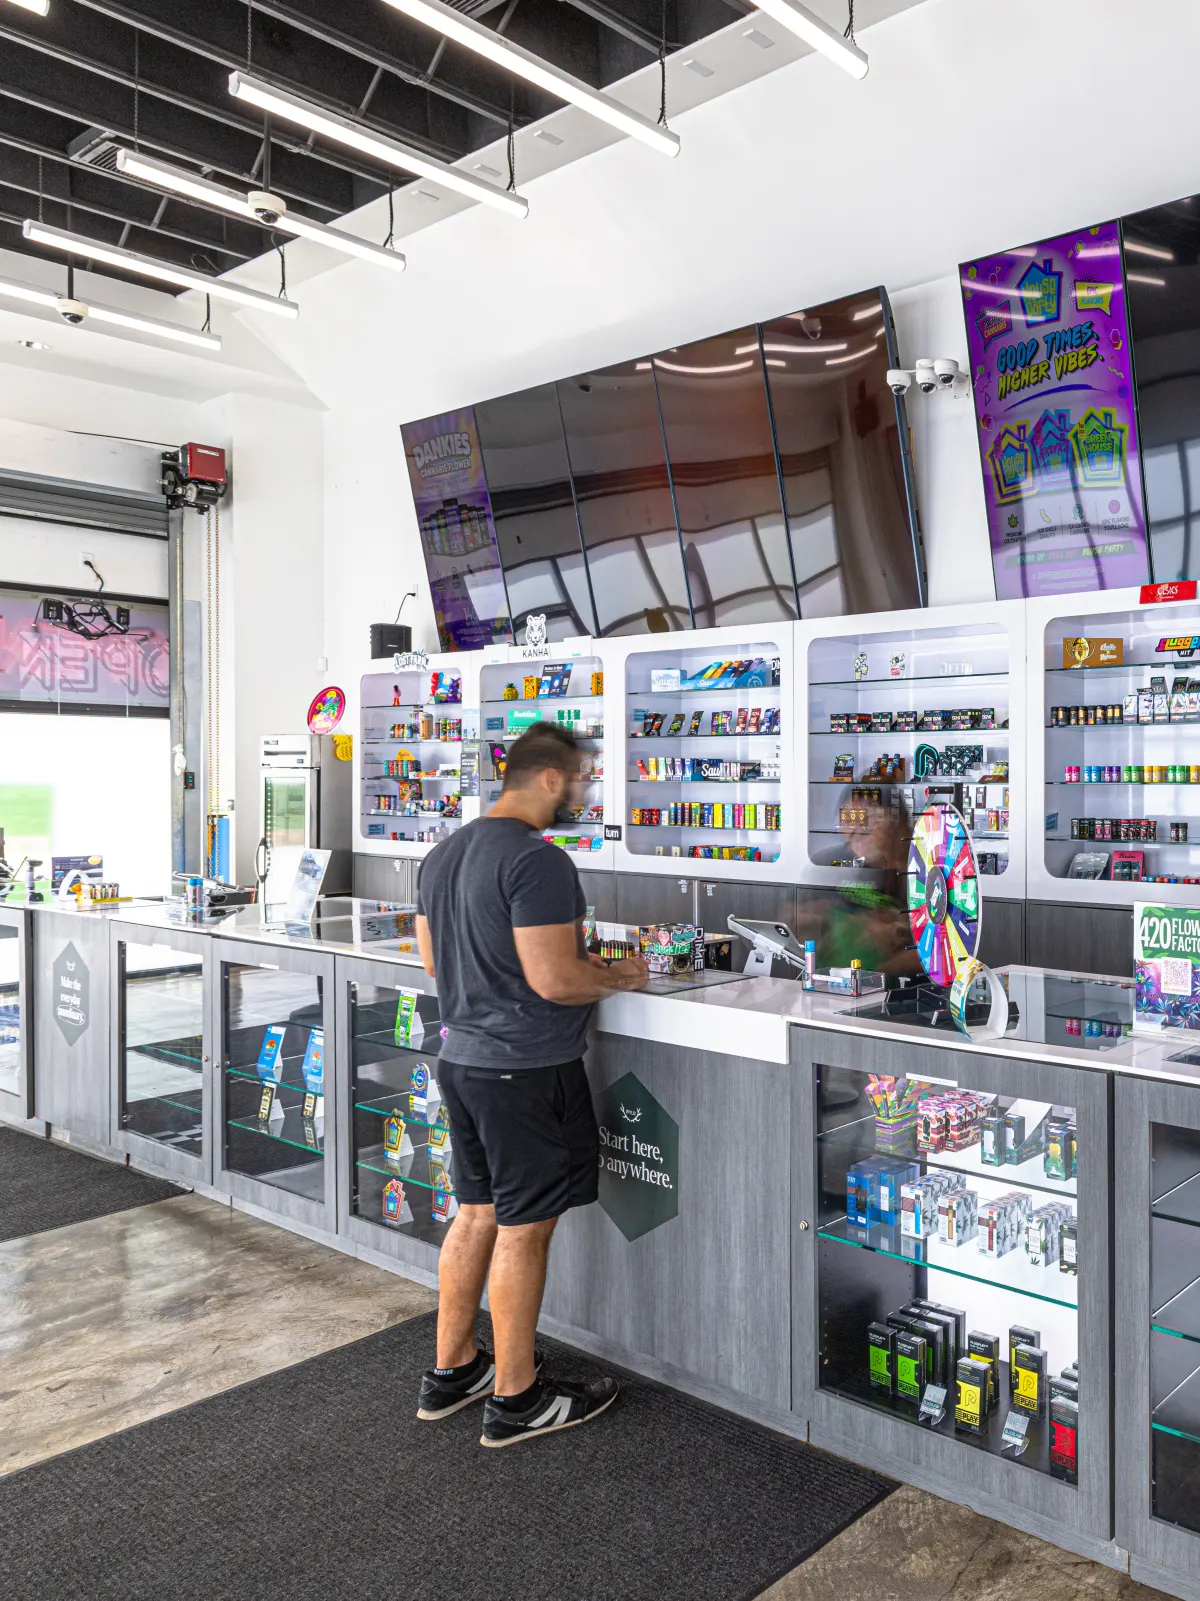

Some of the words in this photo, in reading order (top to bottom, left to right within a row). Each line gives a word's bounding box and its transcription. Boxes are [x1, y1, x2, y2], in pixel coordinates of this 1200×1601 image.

[997, 337, 1040, 373] GOOD
[1043, 320, 1100, 357] TIMES.
[997, 360, 1051, 401] HIGHER
[1053, 343, 1105, 382] VIBES.
[412, 432, 471, 469] DANKIES
[420, 463, 448, 478] CANNABIS
[448, 458, 471, 472] FLOWER
[522, 647, 549, 659] KANHA
[605, 827, 619, 838] turn
[778, 927, 788, 936] 2
[1140, 916, 1172, 949] 420
[654, 942, 691, 956] Buddies
[694, 927, 704, 970] DIME
[598, 1125, 629, 1152] Start
[632, 1134, 664, 1164] here,
[606, 1156, 674, 1190] anywhere.
[1019, 1398, 1037, 1411] PLAY
[962, 1411, 980, 1426] PLAY
[1058, 1455, 1076, 1470] PLAY
